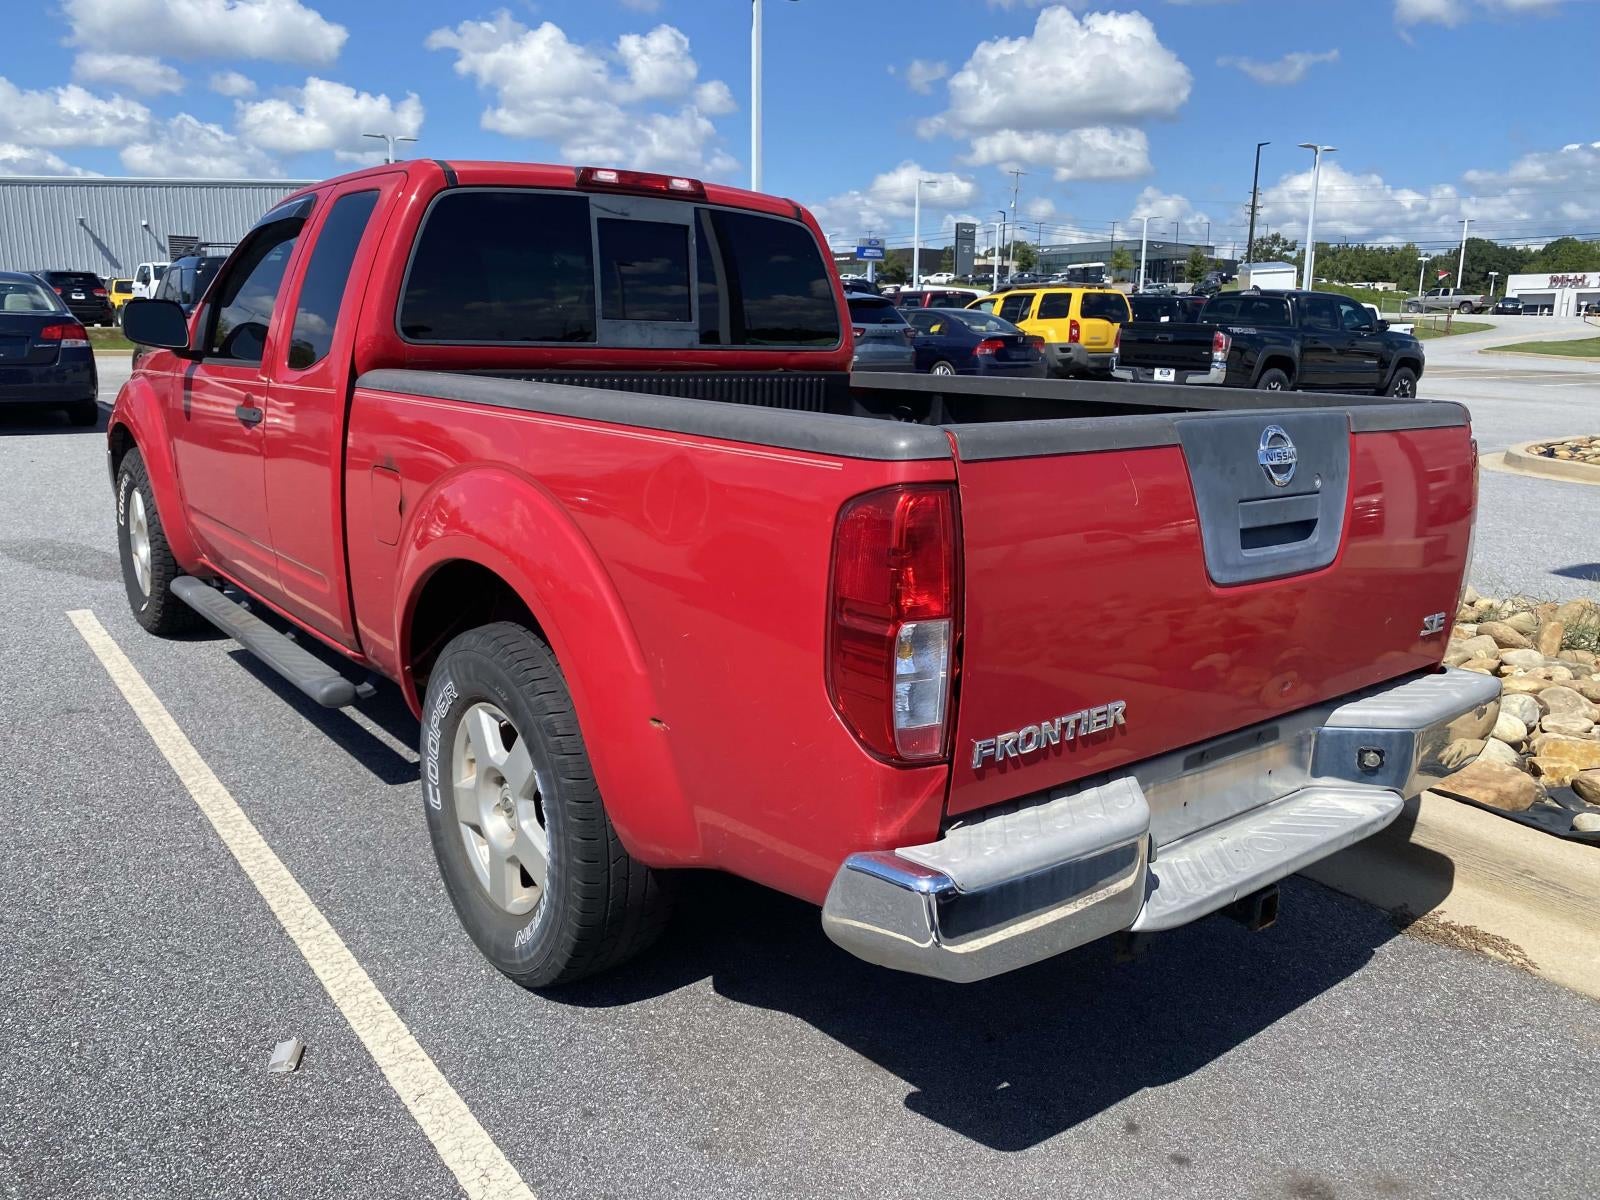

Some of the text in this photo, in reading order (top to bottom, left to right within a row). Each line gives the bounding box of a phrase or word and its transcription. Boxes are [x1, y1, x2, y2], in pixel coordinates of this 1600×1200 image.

[1265, 451, 1297, 462] NISSAN
[1420, 611, 1446, 637] SE
[427, 681, 459, 810] COOPER
[970, 700, 1127, 769] FRONTIER
